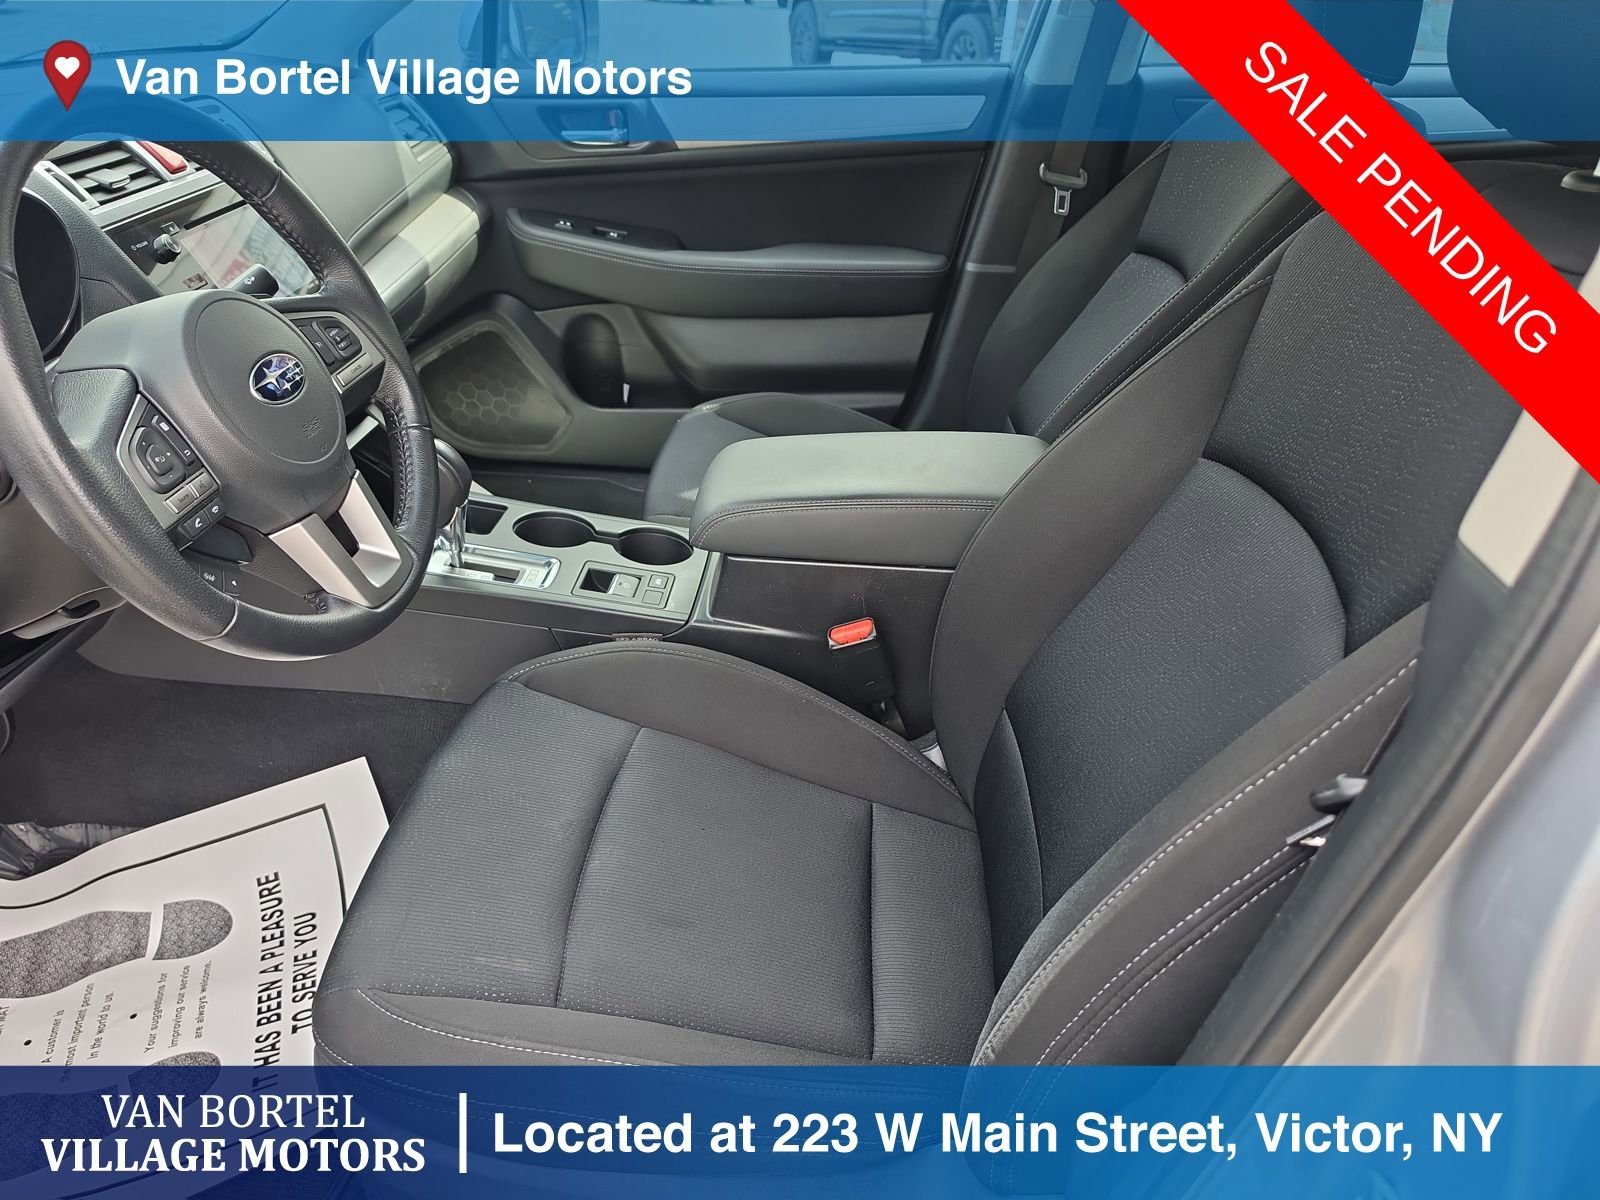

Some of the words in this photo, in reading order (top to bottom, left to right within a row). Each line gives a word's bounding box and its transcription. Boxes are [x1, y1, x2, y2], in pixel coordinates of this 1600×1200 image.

[256, 871, 285, 961] PLEASURE
[293, 911, 318, 949] YOU
[157, 972, 169, 983] for
[179, 965, 191, 991] service
[259, 962, 284, 974] A
[291, 949, 318, 1004] SERVE
[81, 982, 95, 1008] person
[150, 984, 166, 1031] suggestions
[176, 992, 185, 1005] our
[256, 978, 283, 1028] BEEN
[53, 1009, 65, 1017] is
[100, 1004, 112, 1013] to
[195, 995, 209, 1024] always
[291, 1008, 312, 1035] TO
[46, 1018, 62, 1055] customer
[67, 1008, 88, 1044] important
[96, 1013, 109, 1035] world
[168, 1006, 186, 1049] improving
[194, 1026, 204, 1039] are
[64, 1044, 78, 1068] most
[87, 1050, 99, 1060] in
[90, 1036, 103, 1050] the
[143, 1033, 157, 1054] Your
[253, 1030, 282, 1070] HAS
[250, 1073, 279, 1093] IT
